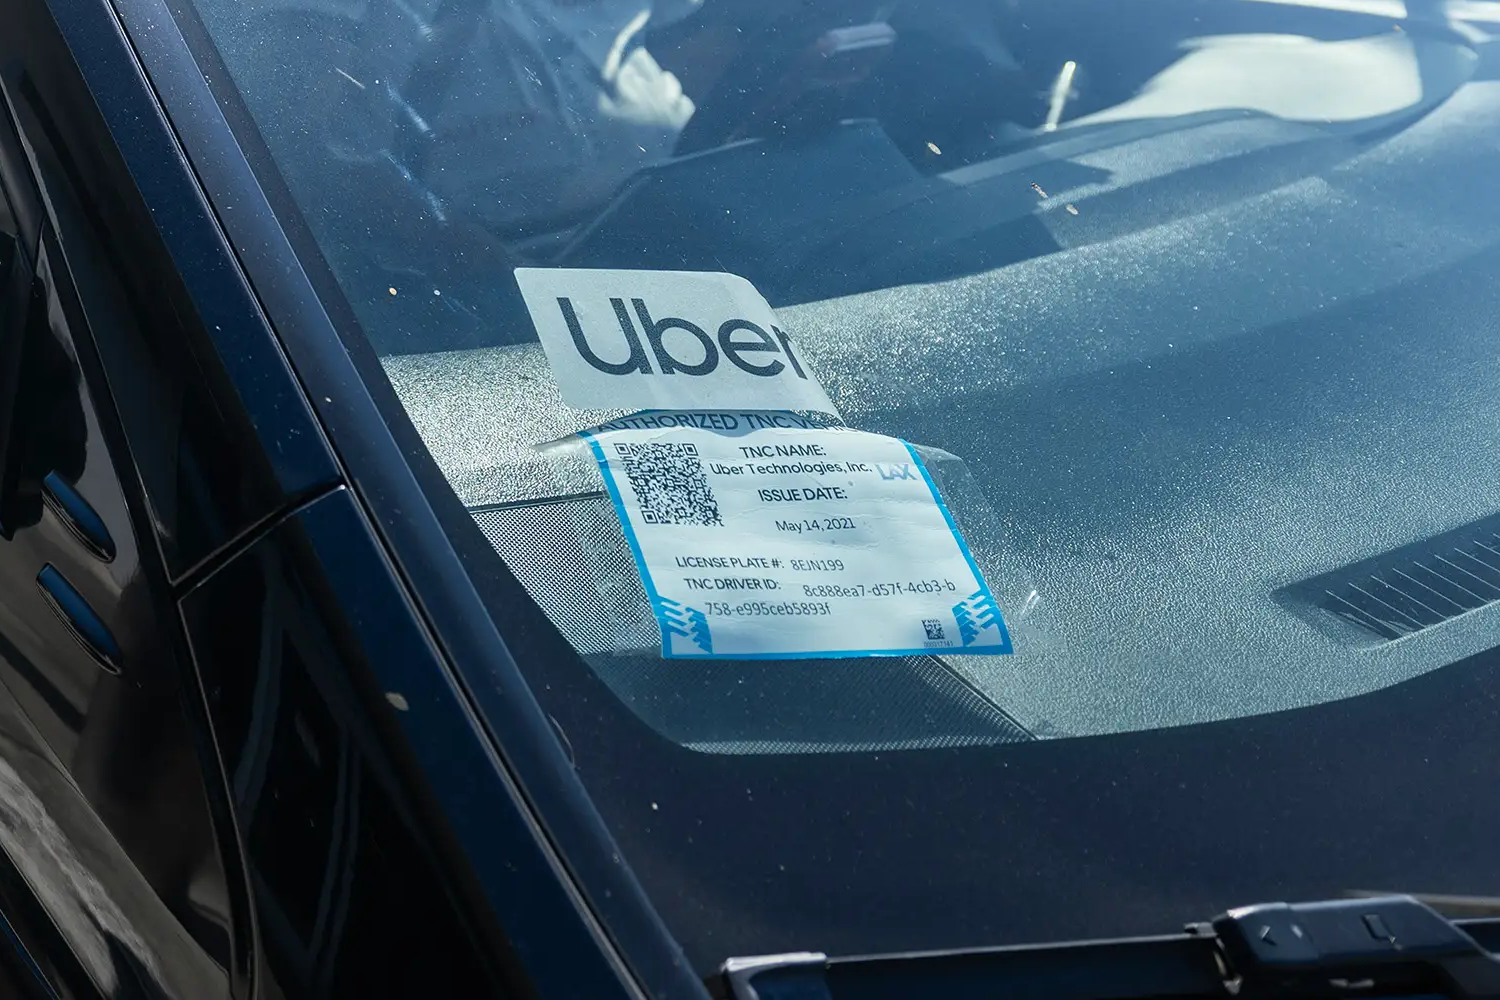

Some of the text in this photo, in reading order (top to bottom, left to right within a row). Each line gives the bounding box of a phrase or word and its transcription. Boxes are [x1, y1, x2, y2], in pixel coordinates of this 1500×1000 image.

[556, 297, 808, 380] Uber
[598, 413, 739, 431] AUTHORIZED
[742, 413, 790, 429] TNC
[739, 444, 827, 459] TNC NAME:
[709, 461, 873, 476] Uber Technologies, Inc.
[875, 463, 918, 481] LAX
[757, 487, 848, 502] ISSUE DATE:
[775, 520, 802, 534] May
[675, 556, 845, 571] LICENSE PLATE #: 8EJN199
[683, 578, 714, 590] TNC
[714, 578, 762, 590] DRIVER
[764, 579, 782, 590] ID:
